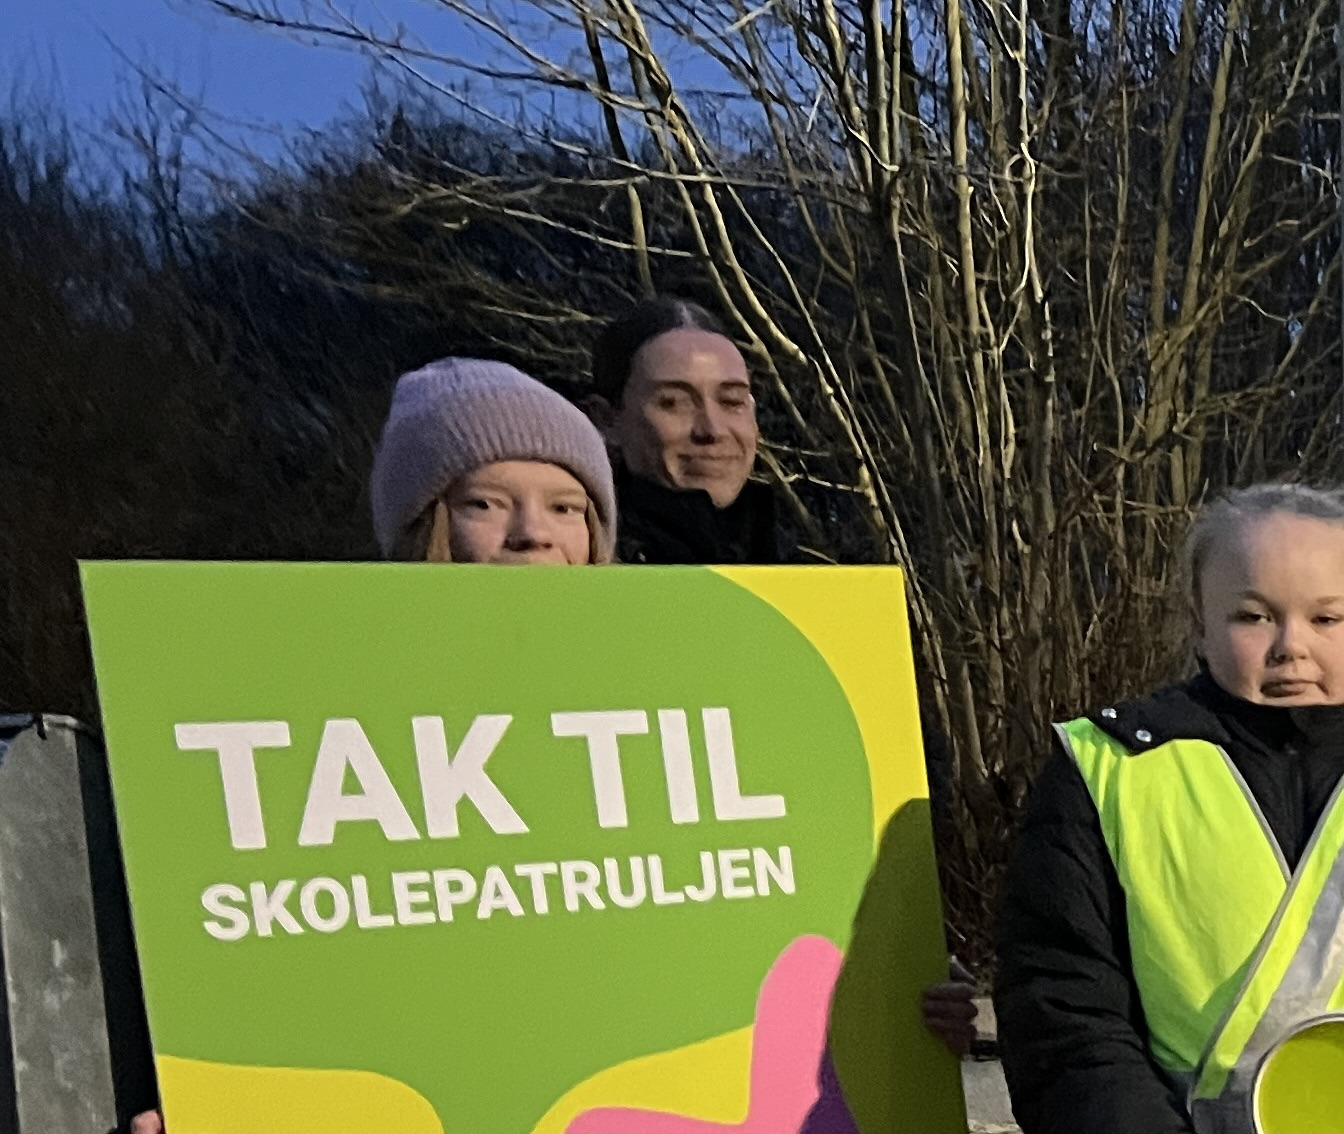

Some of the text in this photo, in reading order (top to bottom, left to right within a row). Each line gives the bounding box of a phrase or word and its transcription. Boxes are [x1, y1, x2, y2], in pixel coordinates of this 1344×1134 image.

[174, 707, 787, 850] TAK TIL
[201, 846, 796, 941] SKOLEPATRULJEN
